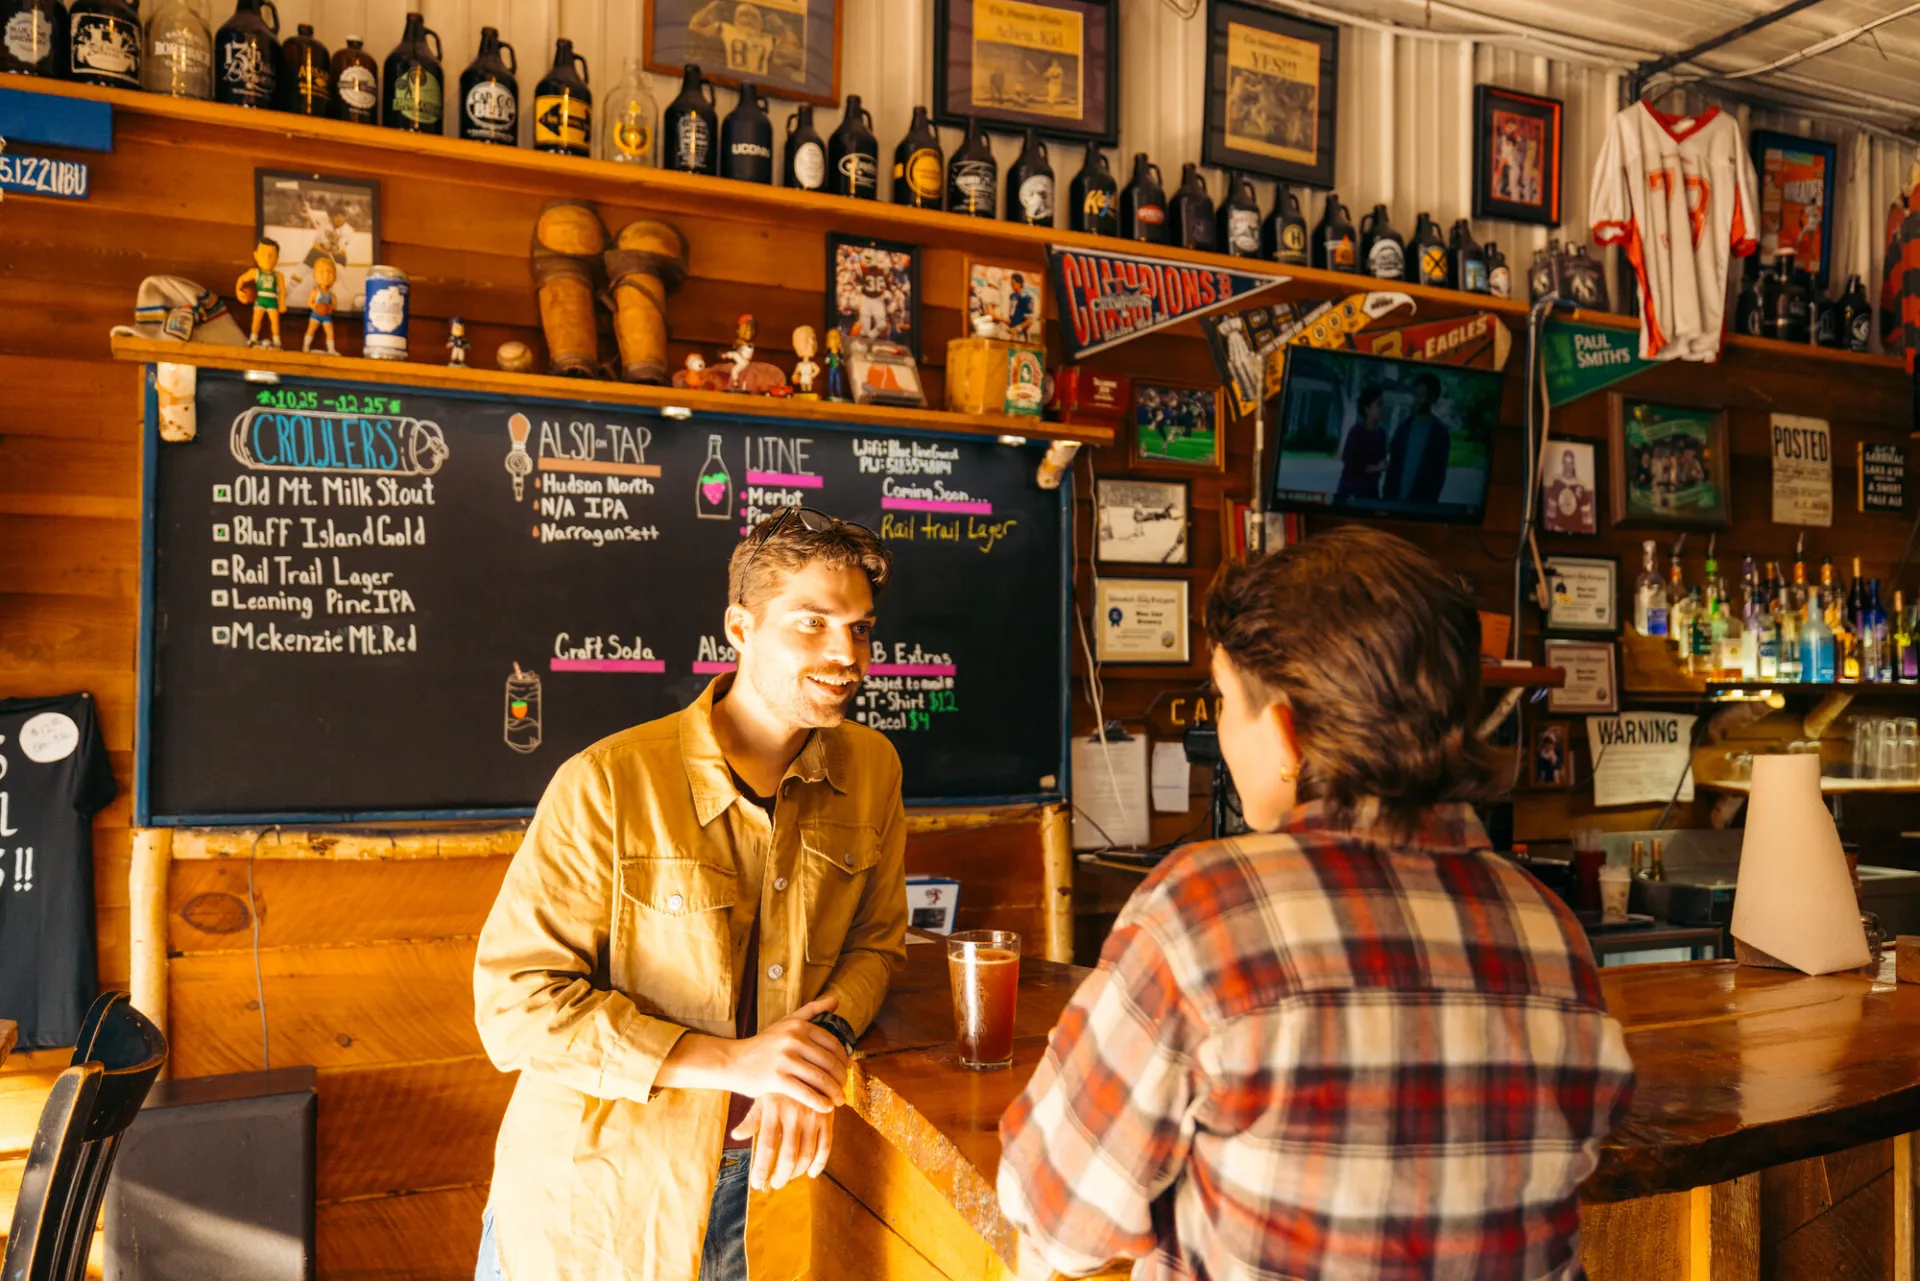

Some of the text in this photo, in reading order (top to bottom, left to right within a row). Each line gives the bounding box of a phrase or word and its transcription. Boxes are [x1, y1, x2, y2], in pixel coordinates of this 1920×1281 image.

[731, 38, 767, 72] 87
[731, 143, 770, 158] UCONN
[1425, 315, 1488, 360] EAGLES
[1573, 333, 1611, 351] PAUL
[253, 413, 399, 470] CROWLERS
[539, 421, 595, 461] ALSO
[605, 424, 652, 464] TAP
[1774, 425, 1828, 462] POSTED
[745, 436, 815, 476] WINE
[234, 475, 435, 507] Old Mt. Milk Stout
[542, 473, 655, 495] Hudson North
[747, 487, 803, 506] Merlot
[882, 477, 933, 502] Coming
[541, 496, 629, 520] N/A IPA
[300, 515, 374, 548] Island
[377, 515, 426, 546] Gold
[541, 522, 660, 547] Narragansett
[881, 512, 1017, 553] Rail trail Lager
[232, 554, 394, 594] Rail Trail Lager
[232, 588, 416, 619] Leaning Pine IPA
[231, 621, 417, 655] Mckenzie Mt. Red
[608, 635, 656, 660] Soda
[698, 635, 737, 662] Also
[894, 642, 953, 666] Extras
[866, 690, 959, 712] T-Shirt $12
[869, 709, 930, 731] Decal $4
[1598, 719, 1678, 745] WARNING
